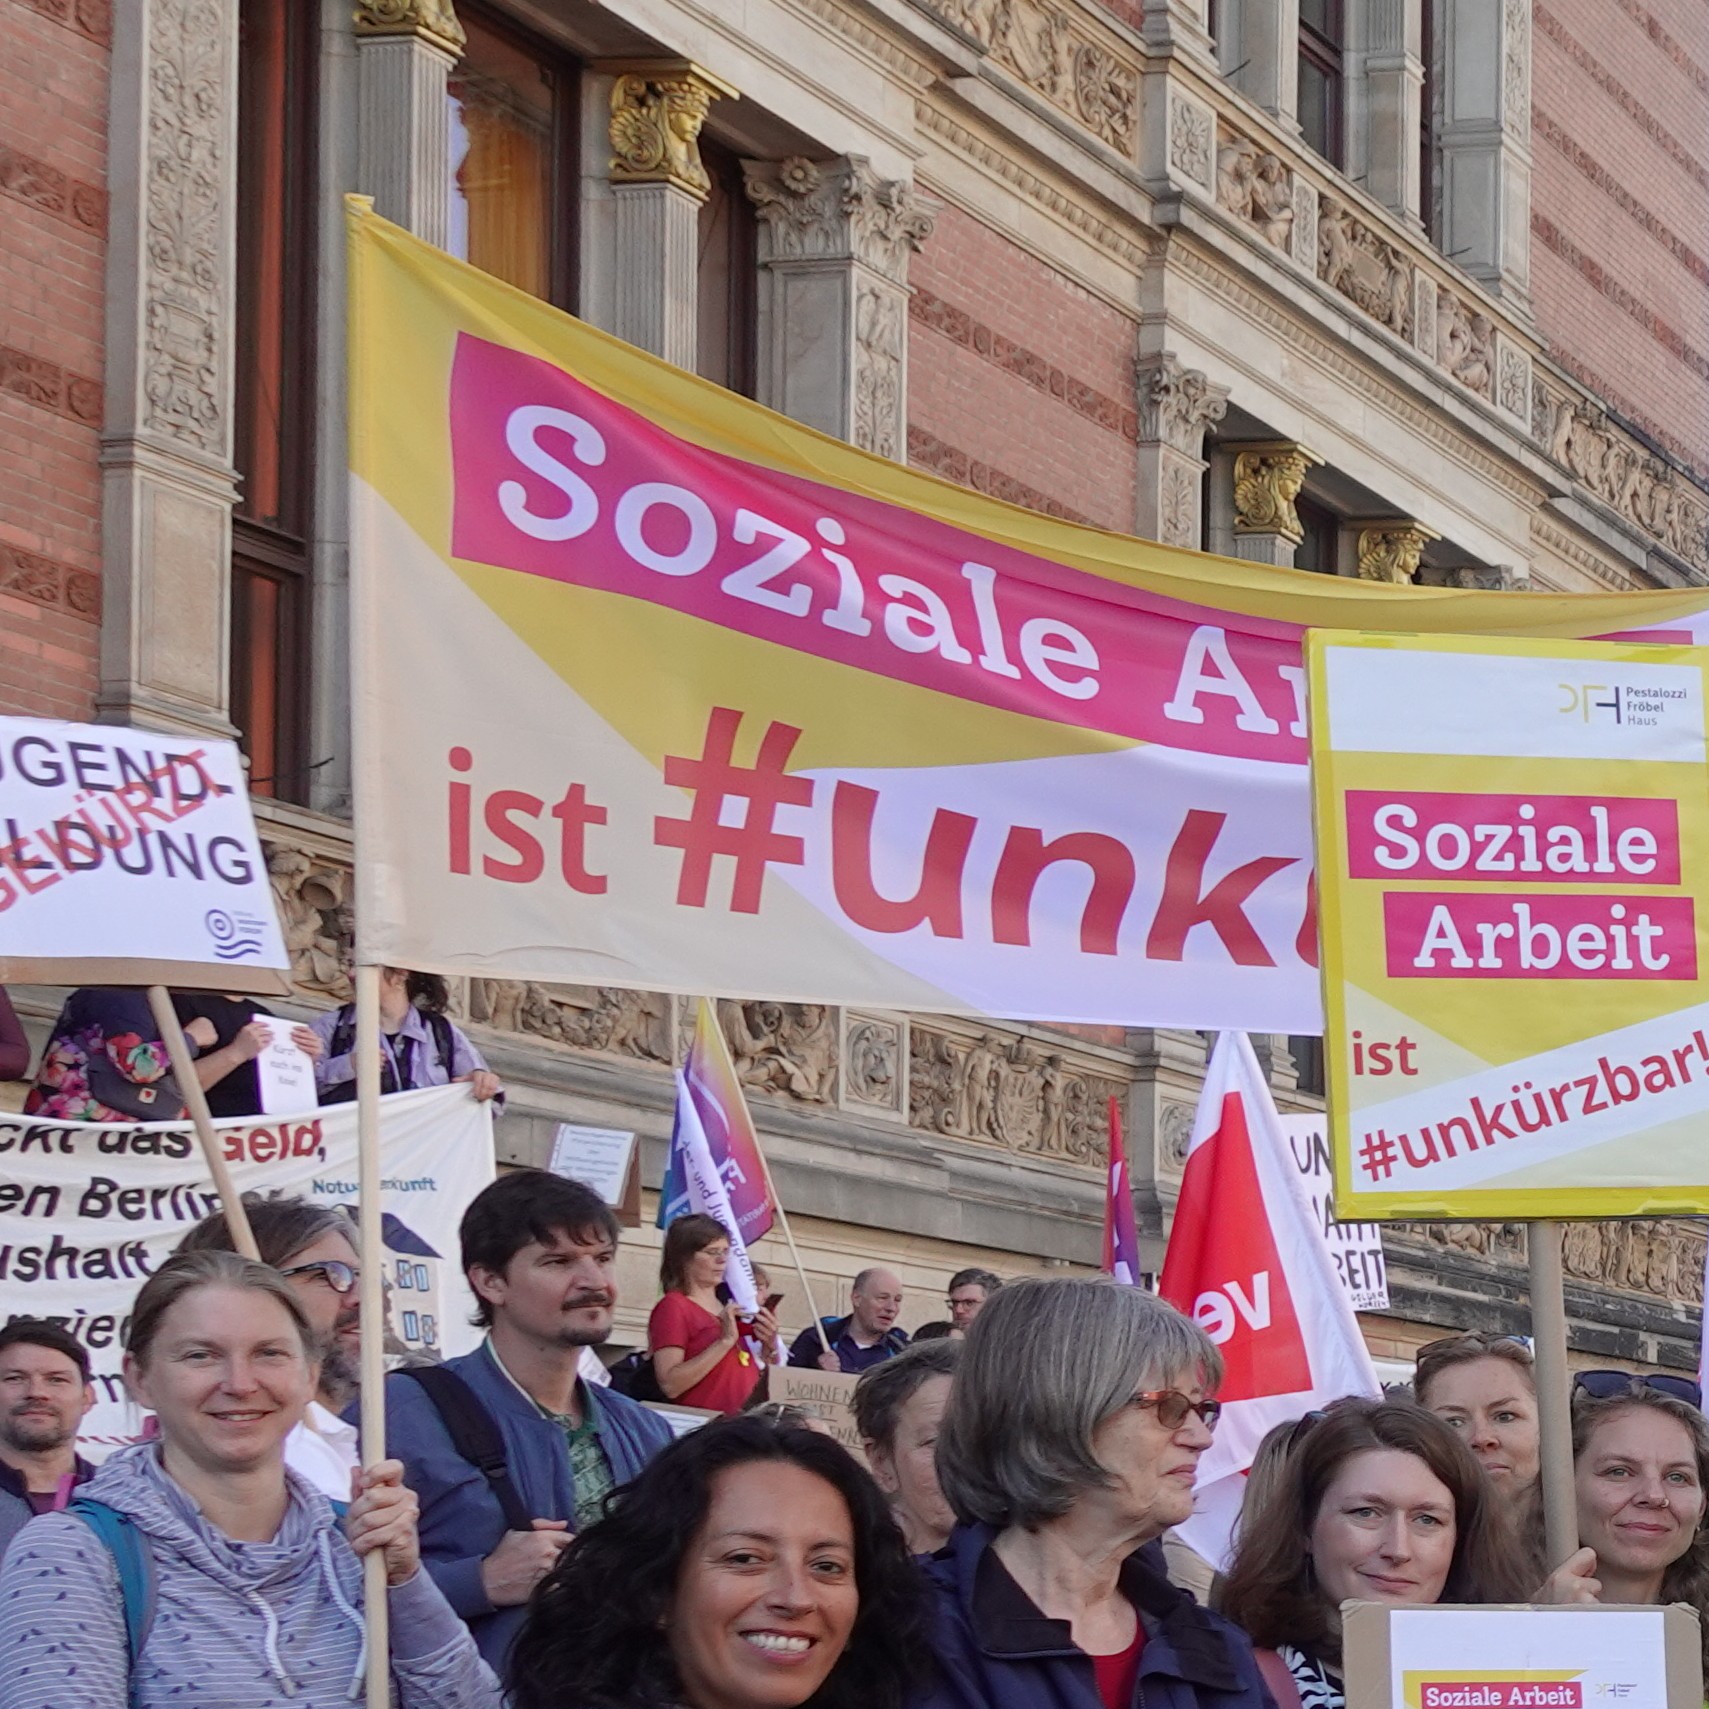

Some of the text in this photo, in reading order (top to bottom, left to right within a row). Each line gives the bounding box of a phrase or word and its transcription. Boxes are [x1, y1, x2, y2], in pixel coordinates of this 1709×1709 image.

[497, 404, 1101, 702] Soziale
[1625, 686, 1688, 704] Pestalozzi
[1625, 699, 1667, 715] Fröbel
[1625, 714, 1658, 728] Haus
[0, 736, 234, 801] GEND-
[0, 818, 254, 885] LDUNG
[448, 746, 608, 895] ist
[1373, 803, 1659, 875] Soziale
[1412, 903, 1672, 974] Arbeit
[1351, 1029, 1419, 1076] ist
[1425, 1686, 1575, 1707] Soziale Arbeit
